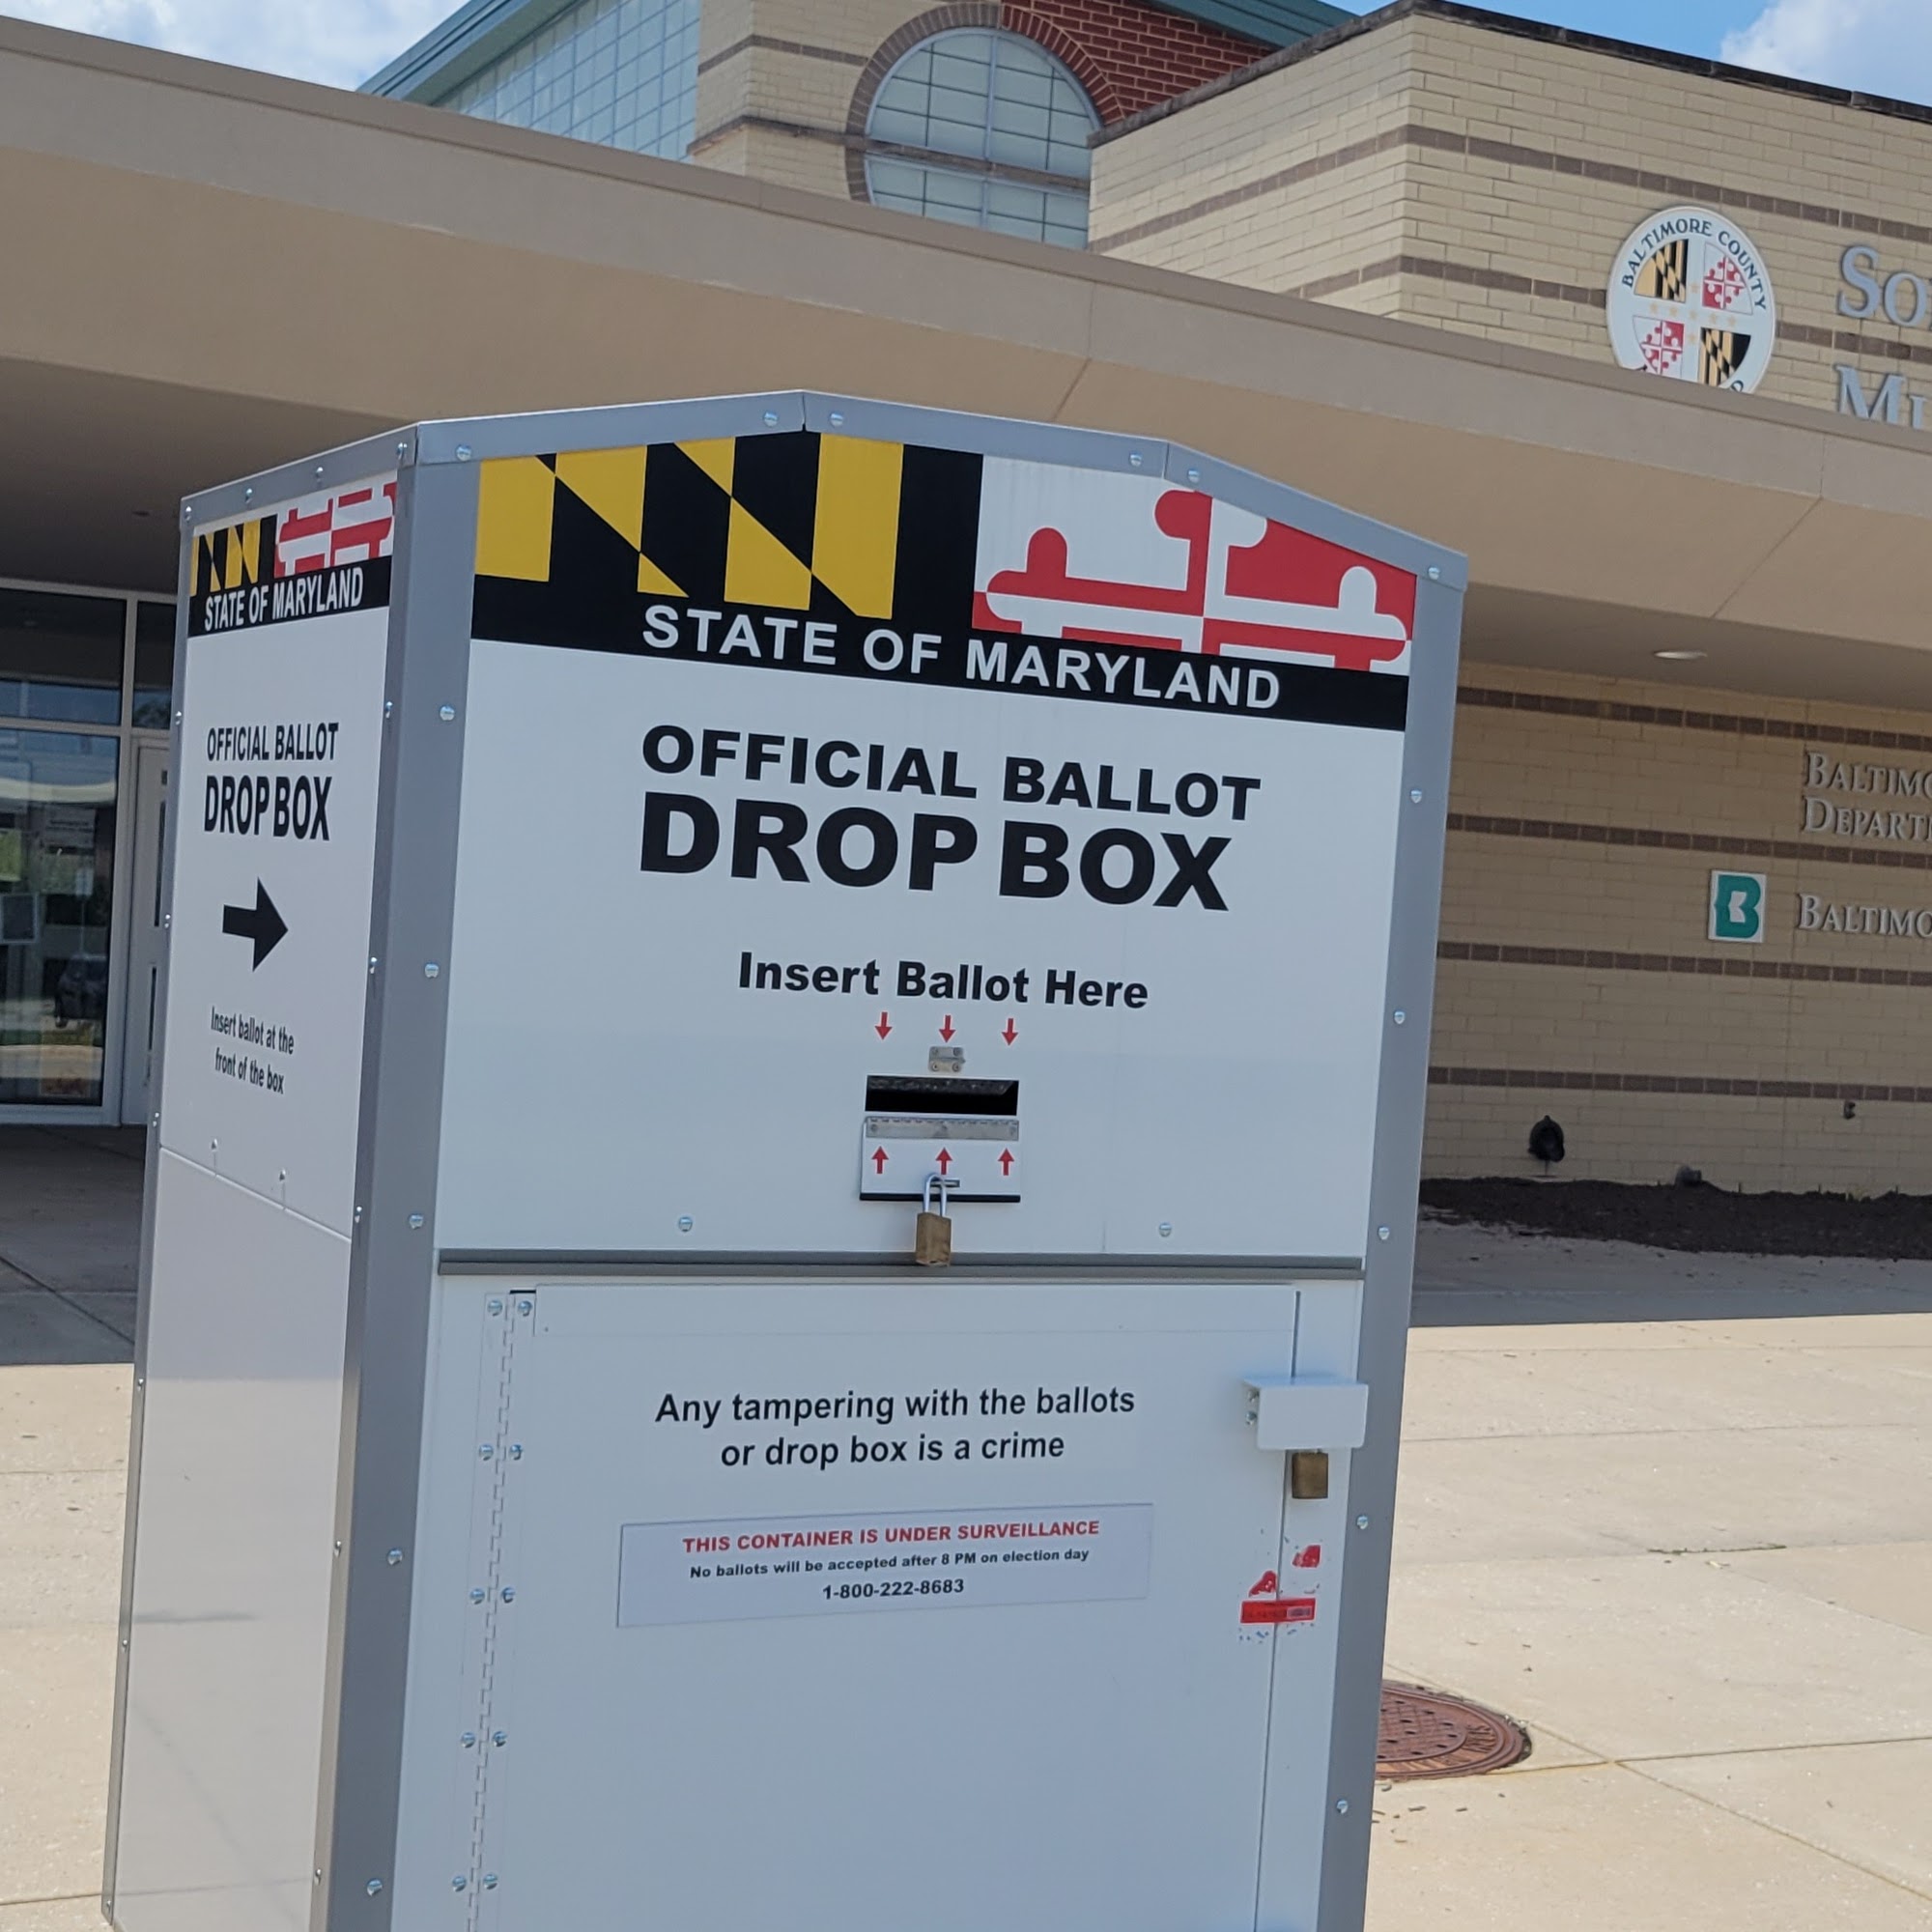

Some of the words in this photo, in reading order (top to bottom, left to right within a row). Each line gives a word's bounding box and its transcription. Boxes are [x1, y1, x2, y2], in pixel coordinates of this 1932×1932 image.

[1621, 217, 1713, 289] BALTIMORE
[1717, 230, 1767, 310] COUNTY
[1838, 245, 1932, 329] SO
[205, 589, 245, 632] STATE
[248, 584, 270, 624] OF
[271, 566, 364, 620] MARYLAND
[642, 605, 838, 667] STATE
[863, 628, 942, 675] OF
[966, 639, 1280, 710] MARYLAND
[207, 725, 270, 762] OFFICIAL
[274, 722, 339, 761] BALLOT
[642, 724, 978, 799] OFFICIAL
[1003, 756, 1262, 821] BALLOT
[204, 775, 270, 836] DROP
[272, 775, 332, 841] BOX
[1803, 795, 1932, 841] DEPART
[639, 791, 978, 892] DROP
[999, 820, 1232, 911] BOX
[739, 952, 880, 996] Insert
[896, 960, 1030, 1004] Ballot
[1044, 969, 1149, 1009] Here
[211, 1006, 237, 1037] Insert
[238, 1014, 265, 1046] ballot
[266, 1025, 276, 1050] at
[278, 1026, 295, 1055] the
[214, 1046, 237, 1077] front
[238, 1056, 248, 1081] of
[249, 1059, 265, 1088] the
[267, 1064, 284, 1094] box
[655, 1393, 722, 1430] Any
[731, 1390, 895, 1427] tampering
[905, 1388, 968, 1417] with
[979, 1387, 1026, 1415] the
[1037, 1386, 1135, 1414] ballots
[721, 1444, 755, 1466] or
[765, 1436, 838, 1471] drop
[850, 1435, 907, 1463] box
[919, 1434, 943, 1462] is
[953, 1439, 970, 1461] a
[981, 1431, 1065, 1460] crime
[682, 1536, 730, 1553] THIS
[737, 1530, 853, 1550] CONTAINER
[860, 1528, 878, 1545] IS
[885, 1525, 952, 1543] UNDER
[957, 1520, 1099, 1540] SURVEILLANCE
[690, 1566, 711, 1578] No
[716, 1563, 768, 1577] ballots
[773, 1560, 800, 1574] will
[805, 1560, 823, 1572] be
[827, 1555, 897, 1572] accepted
[901, 1554, 937, 1567] after
[941, 1553, 950, 1566] 8
[954, 1552, 977, 1565] PM
[980, 1553, 998, 1564] on
[1002, 1549, 1060, 1563] election
[1064, 1548, 1090, 1562] day
[822, 1578, 964, 1600] 1-800-222-8683
